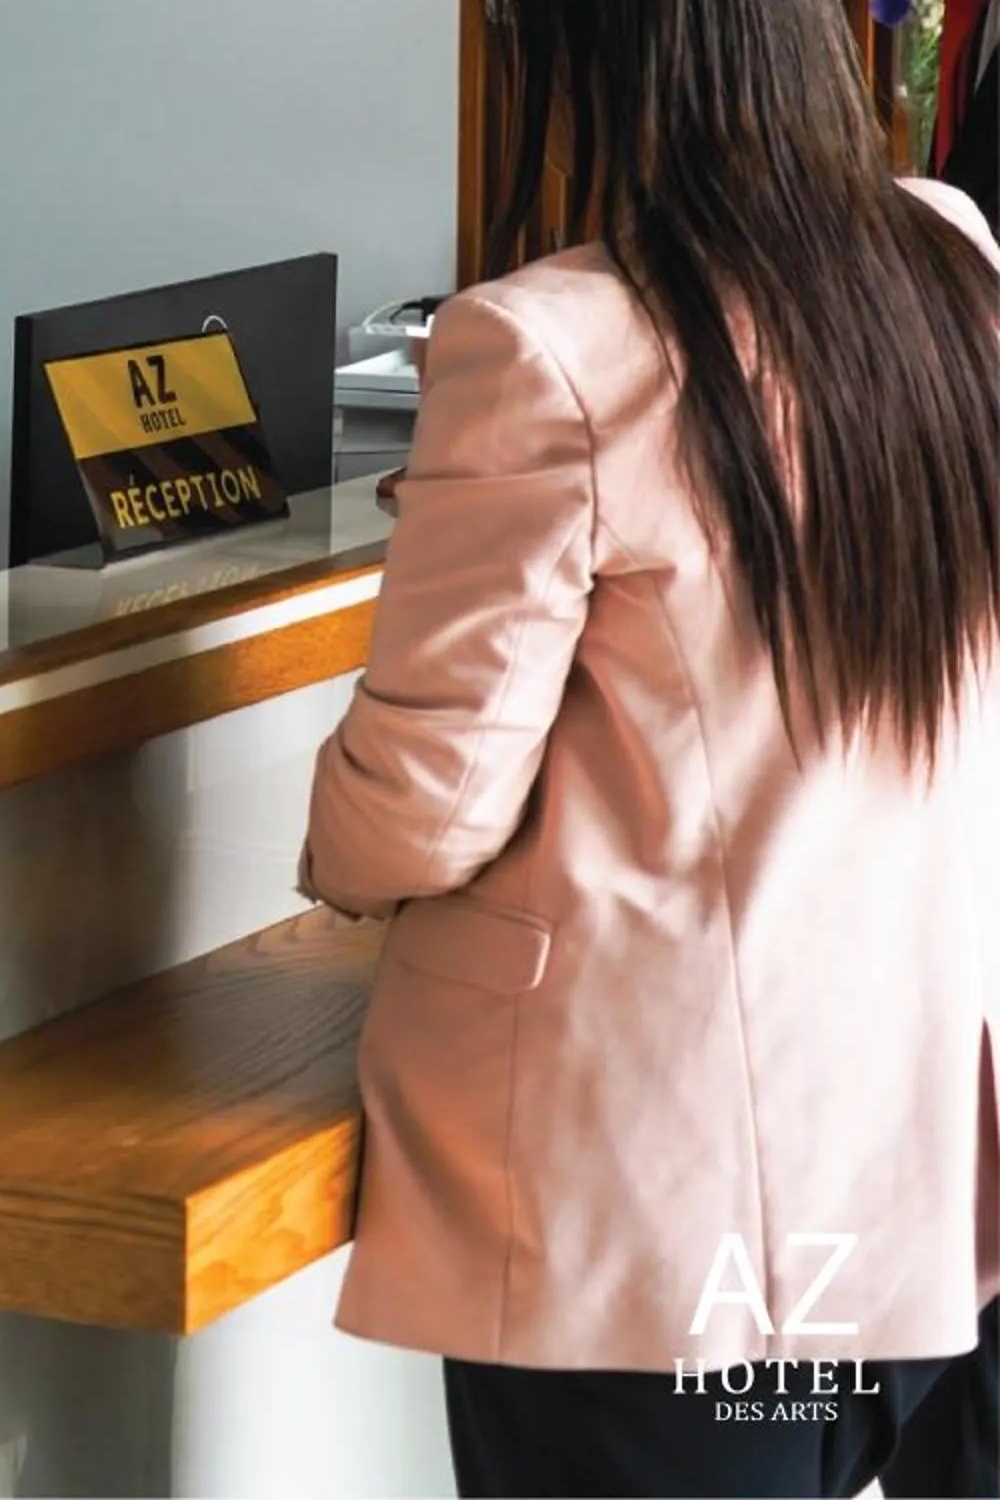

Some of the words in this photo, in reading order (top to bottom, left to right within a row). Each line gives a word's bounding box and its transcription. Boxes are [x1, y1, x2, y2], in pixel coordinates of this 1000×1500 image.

[126, 354, 178, 409] AZ
[139, 408, 187, 434] HOTEL
[110, 466, 262, 529] RÉCEPTION
